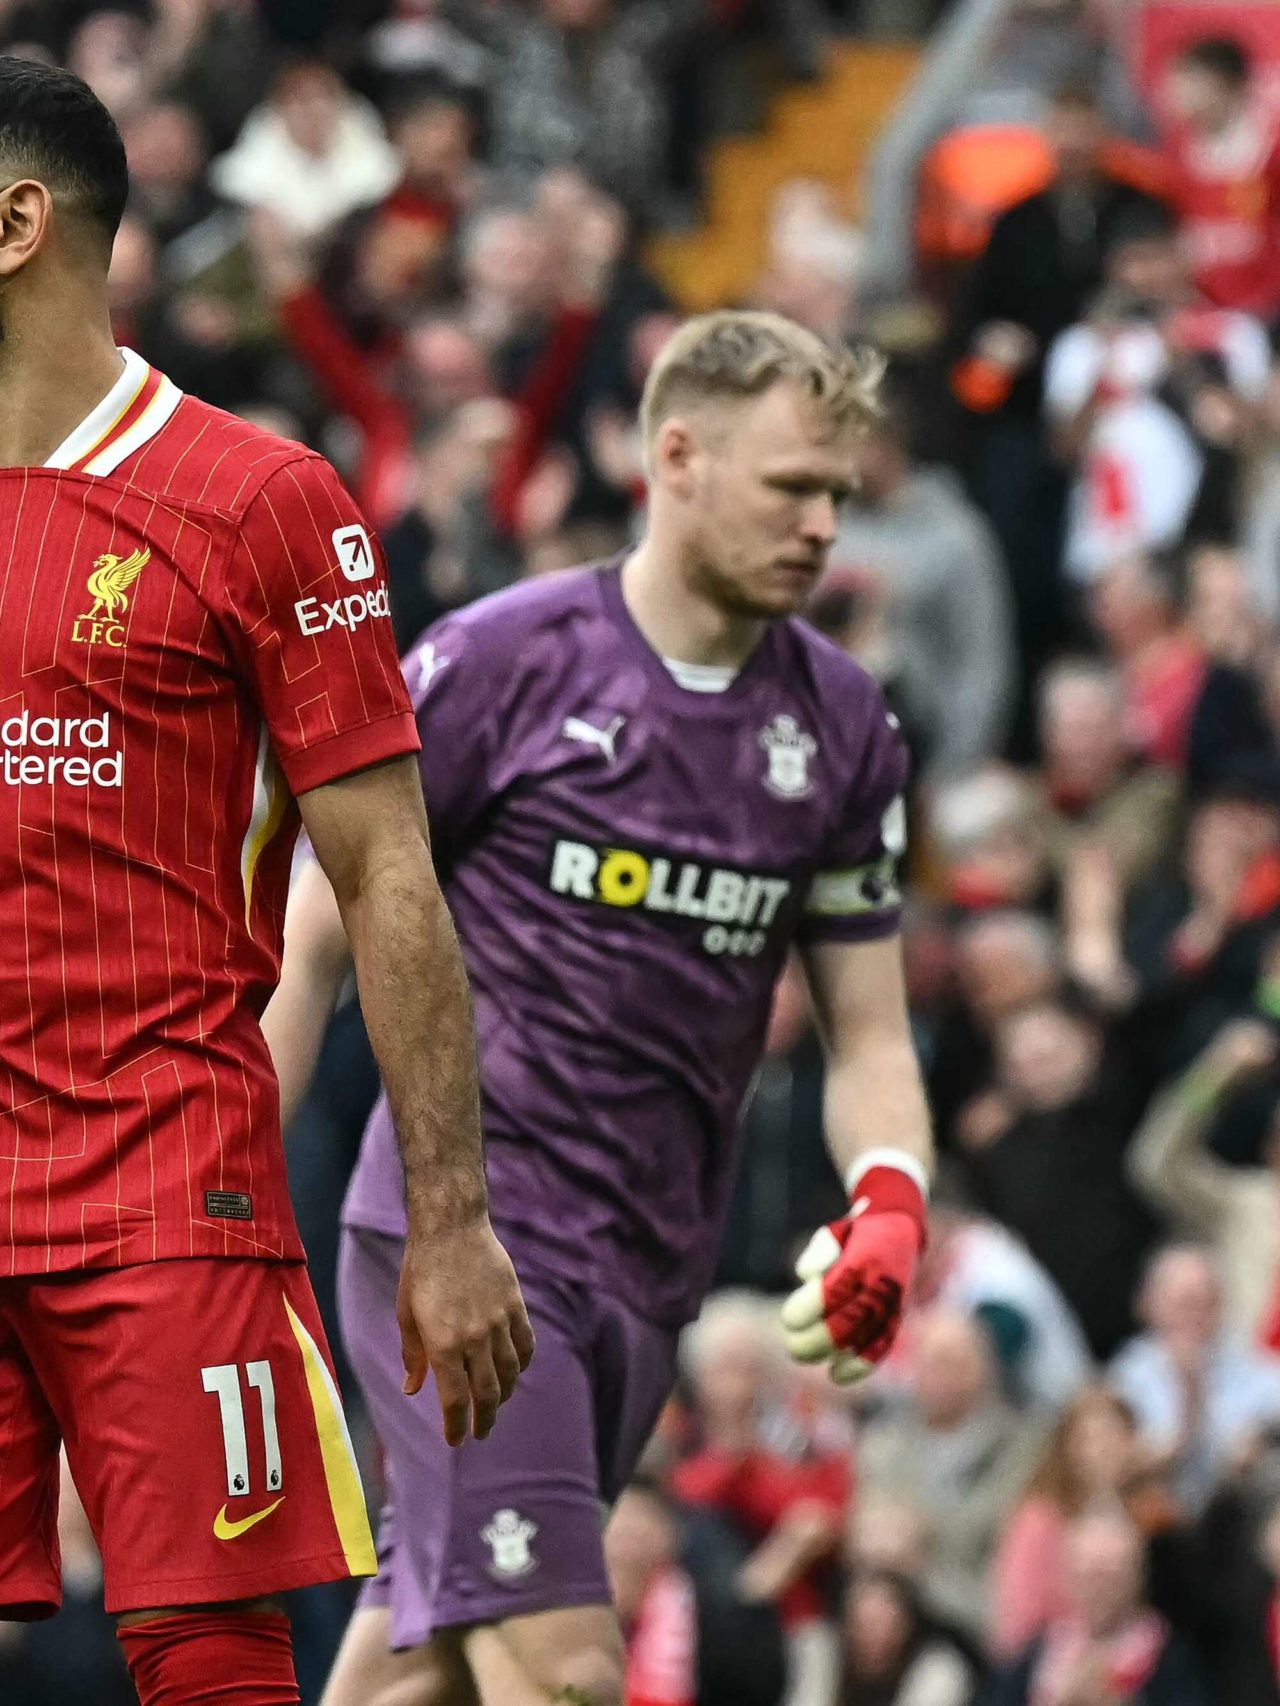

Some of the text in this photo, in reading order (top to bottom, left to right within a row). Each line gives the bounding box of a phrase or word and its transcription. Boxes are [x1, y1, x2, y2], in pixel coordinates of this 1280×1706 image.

[294, 580, 391, 636] Exped
[550, 839, 790, 928] ROLLBIT
[201, 1360, 282, 1497] 11
